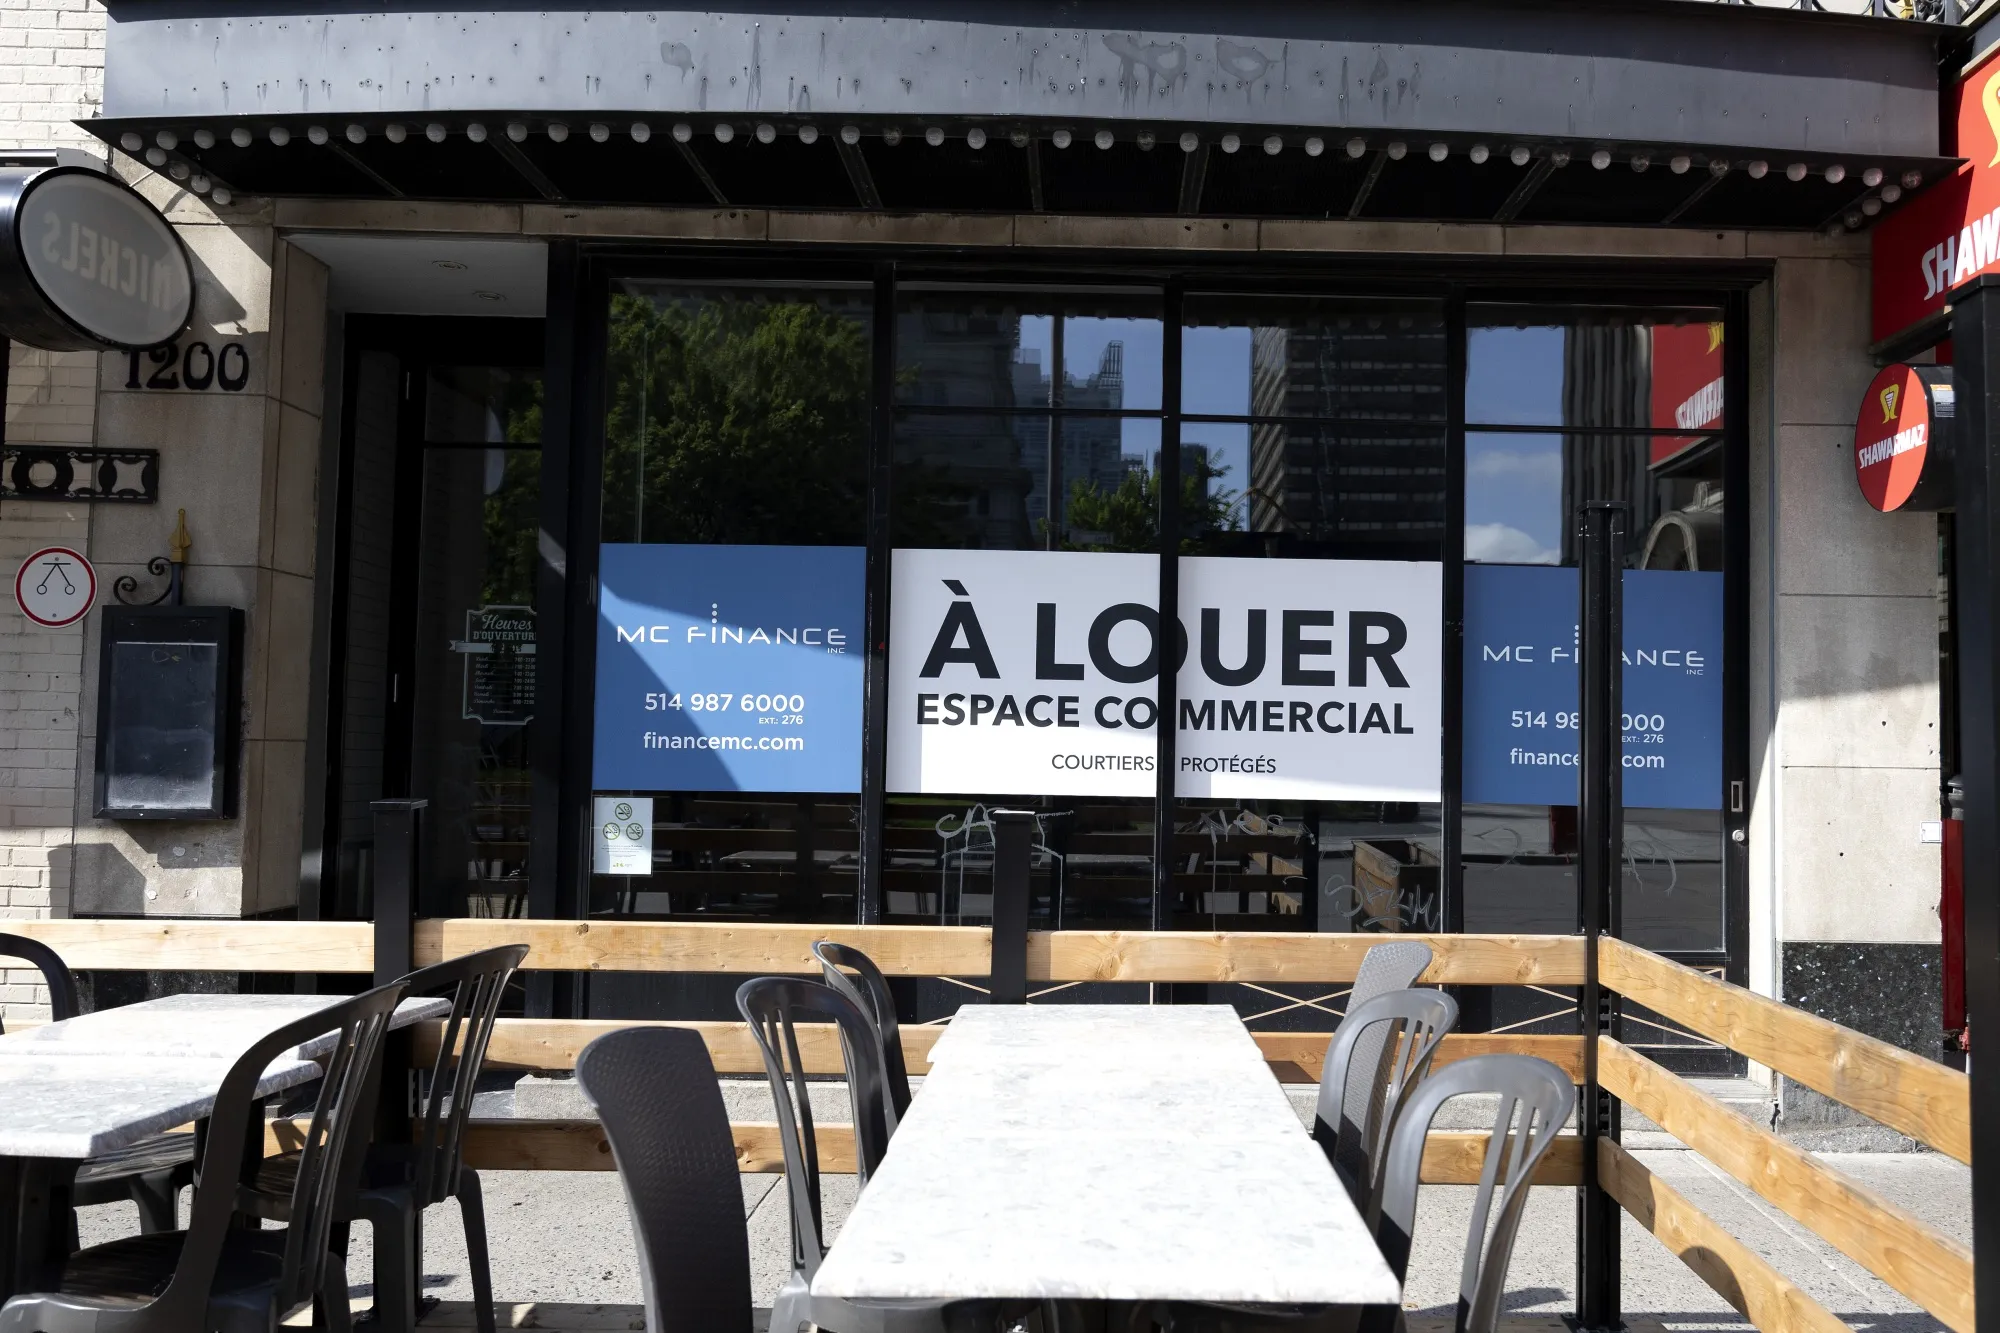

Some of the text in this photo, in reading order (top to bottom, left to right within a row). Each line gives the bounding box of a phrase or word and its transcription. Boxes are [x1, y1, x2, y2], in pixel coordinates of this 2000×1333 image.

[1922, 207, 2000, 300] SHAW
[125, 341, 250, 392] 1200
[1859, 423, 1927, 469] SHAWARMAZ
[482, 614, 533, 630] Heures
[473, 631, 537, 641] D'OUVERTUR
[617, 625, 670, 644] MC
[919, 579, 1411, 688] À LOUER
[1483, 645, 1534, 663] MC
[644, 693, 805, 712] 514 987 6000
[758, 715, 804, 725] EXT.: 276
[917, 693, 1414, 735] ESPACE COMMERCIAL
[1510, 711, 1665, 732] 514 98 000
[643, 731, 804, 751] financemc.com
[1643, 733, 1664, 744] 276
[1051, 754, 1277, 774] COURTIERS PROTÉGÉS
